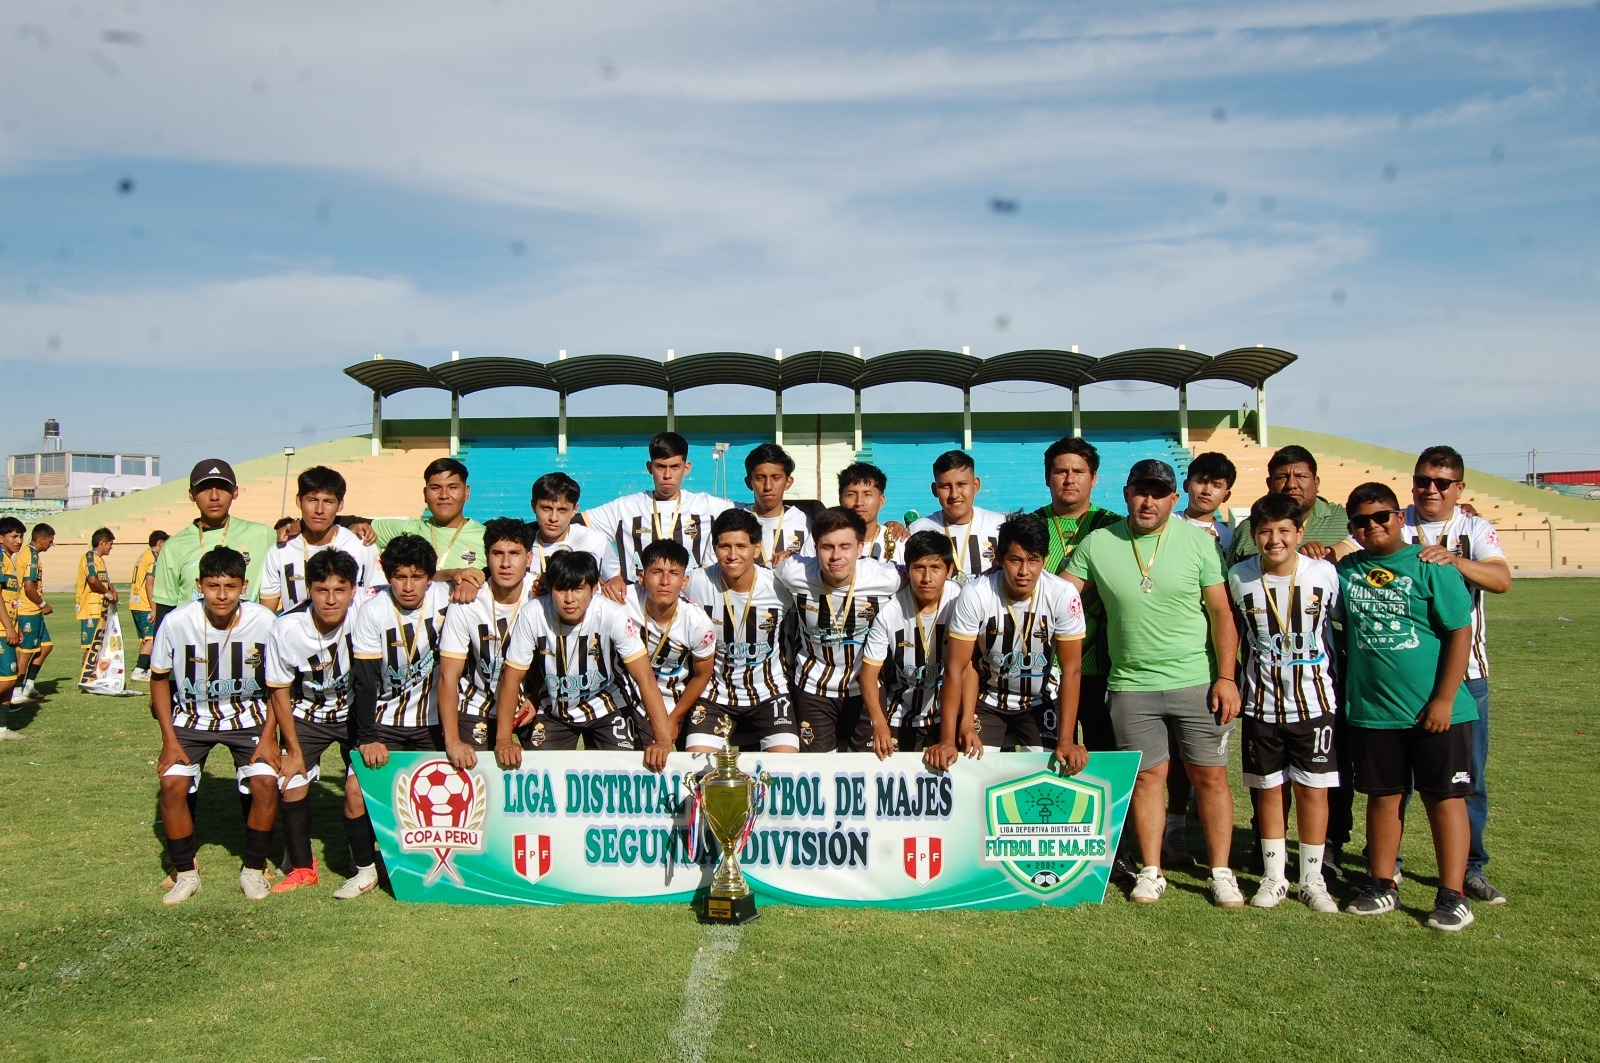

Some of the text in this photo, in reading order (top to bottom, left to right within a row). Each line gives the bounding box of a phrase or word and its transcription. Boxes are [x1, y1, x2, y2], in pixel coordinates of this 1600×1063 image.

[180, 676, 262, 697] ACQUA
[769, 696, 791, 718] 17
[1313, 725, 1333, 754] 10
[503, 773, 556, 813] LIGA
[565, 773, 686, 815] DISTRITAL
[835, 776, 866, 816] DE
[875, 776, 953, 817] MAJES
[404, 830, 478, 845] COPA PERÚ
[1000, 825, 1091, 834] LIGA DEPORTIVA DISTRITAL DE
[739, 820, 869, 867] DIVISIÓN
[985, 836, 1106, 857] FÚTBOL DE MAJES
[1035, 861, 1056, 869] 2002
